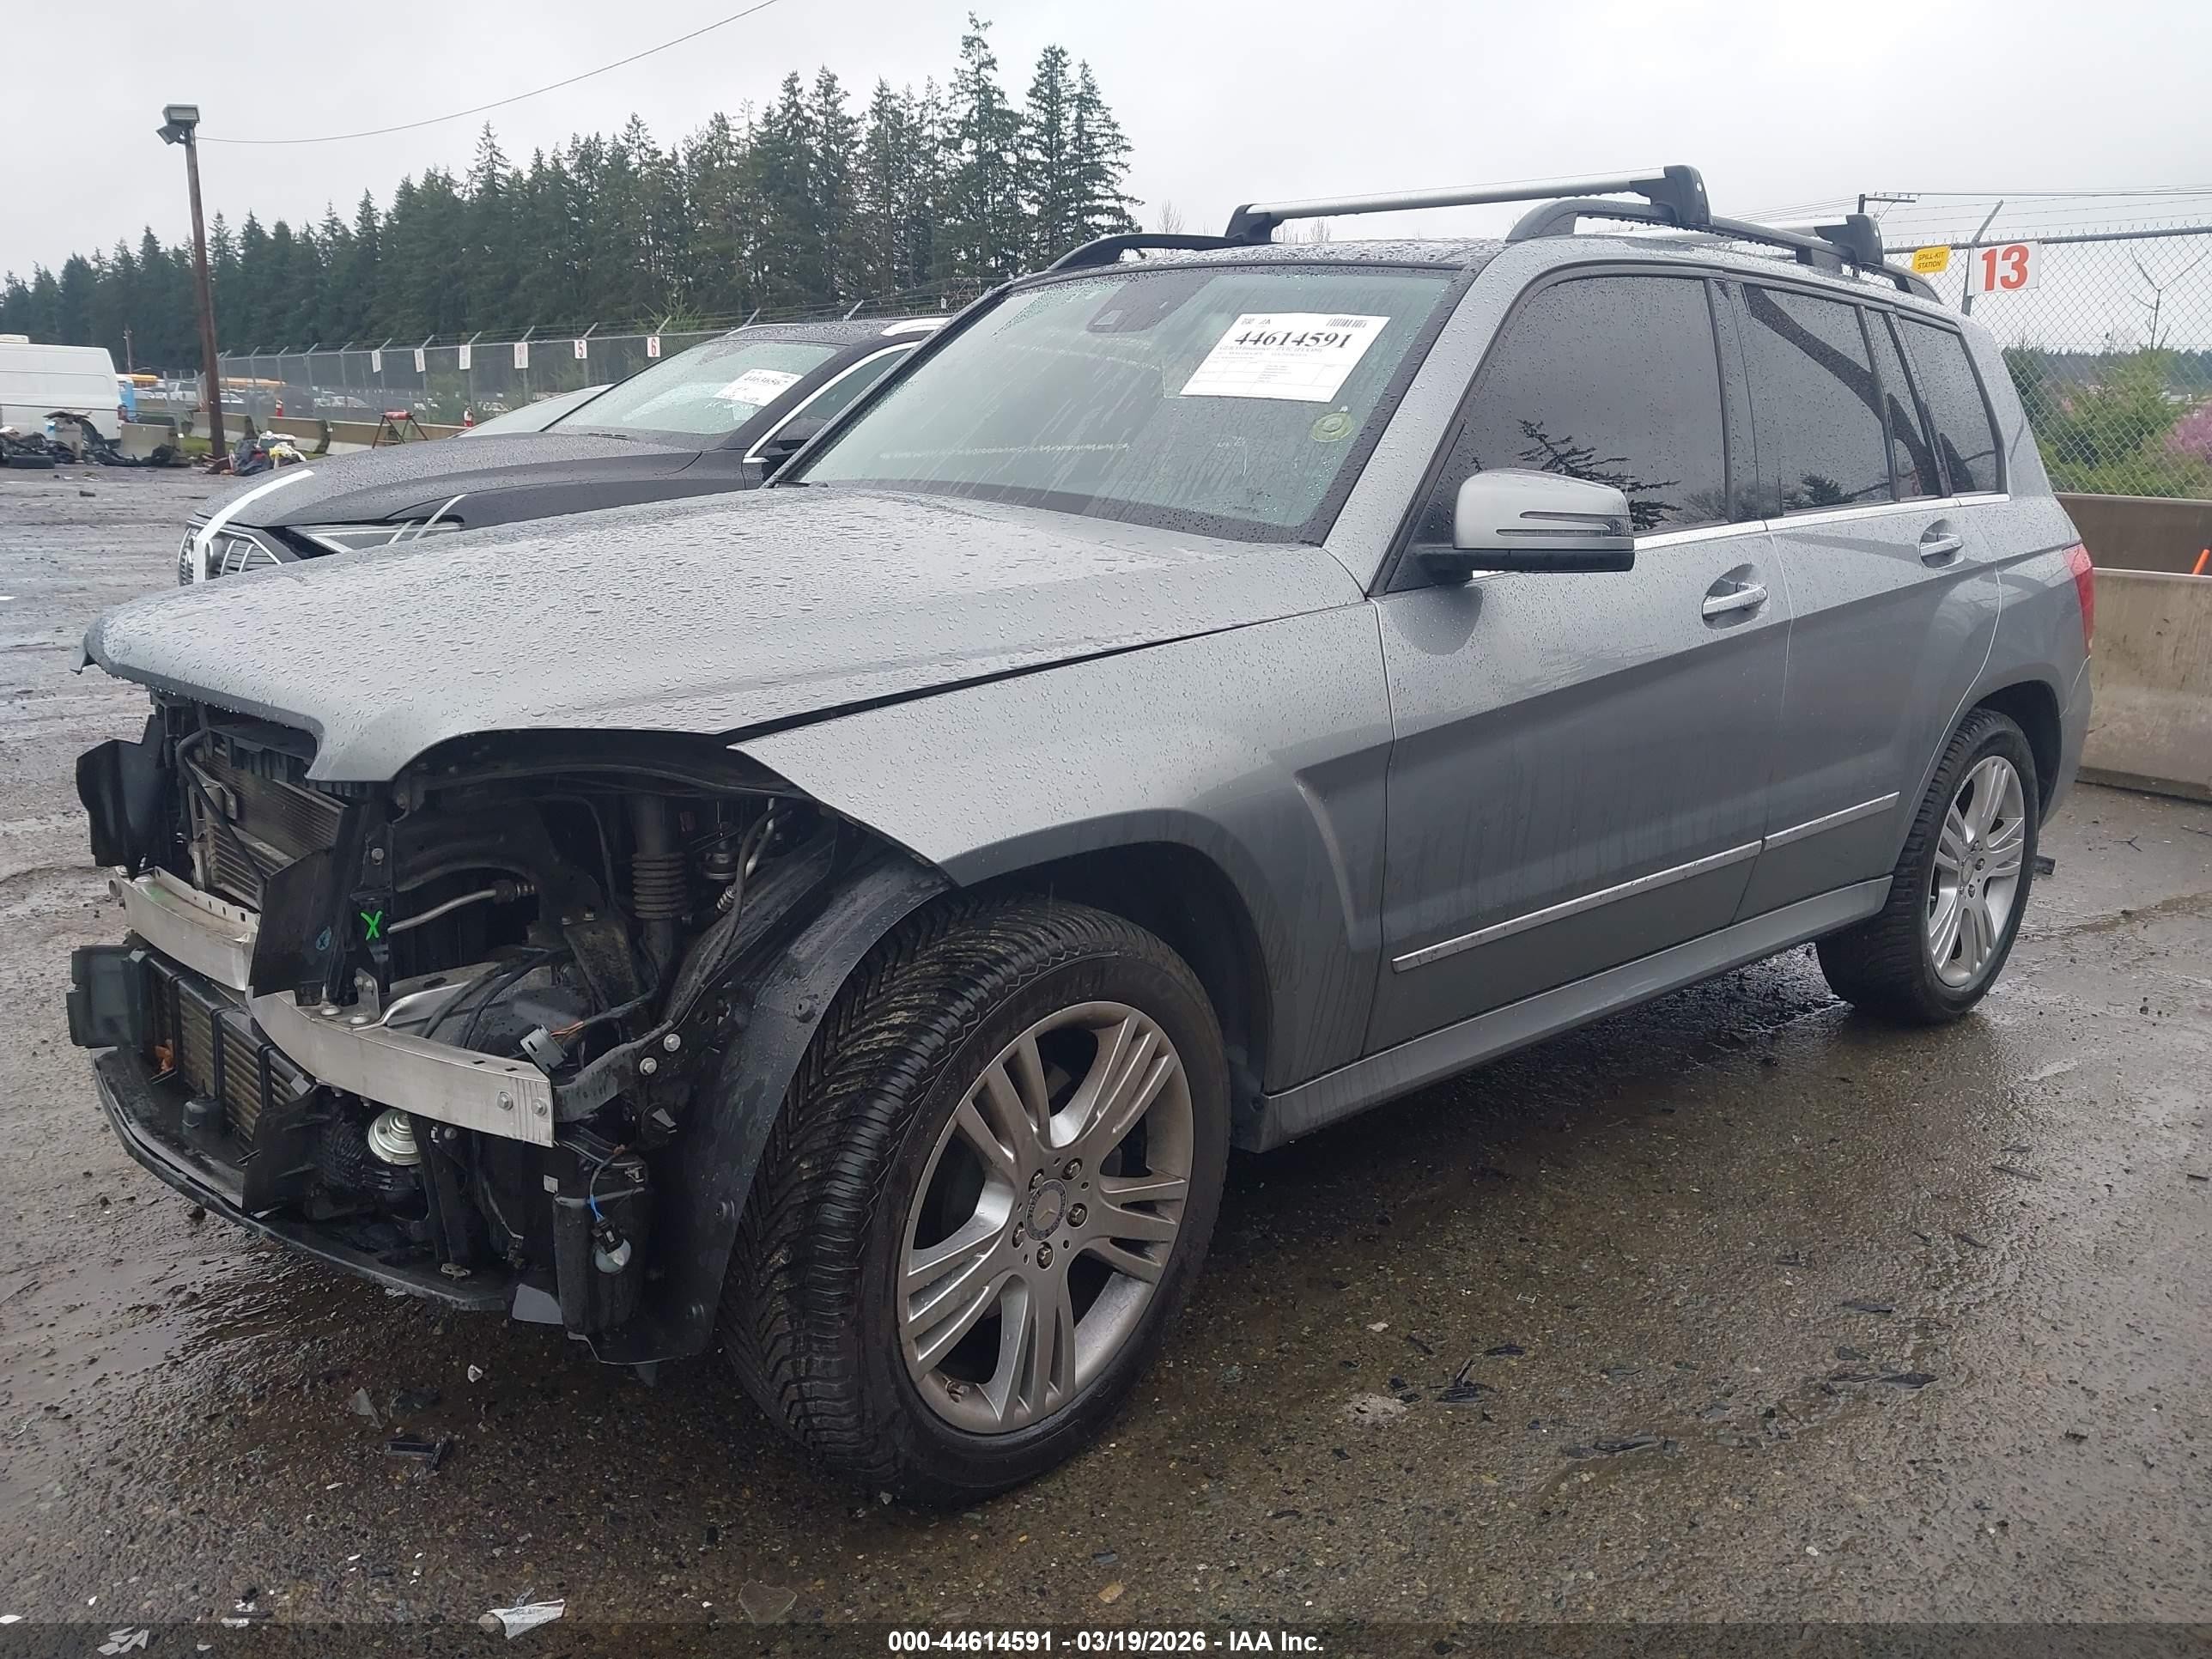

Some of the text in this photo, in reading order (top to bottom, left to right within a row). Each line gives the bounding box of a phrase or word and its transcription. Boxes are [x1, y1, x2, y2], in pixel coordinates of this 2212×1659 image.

[1917, 251, 1945, 261] SPILL-KIT
[1917, 260, 1942, 270] STATION
[1982, 245, 2029, 291] 13
[650, 338, 657, 356] 6
[1235, 331, 1352, 349] 44614591
[577, 341, 584, 358] 5
